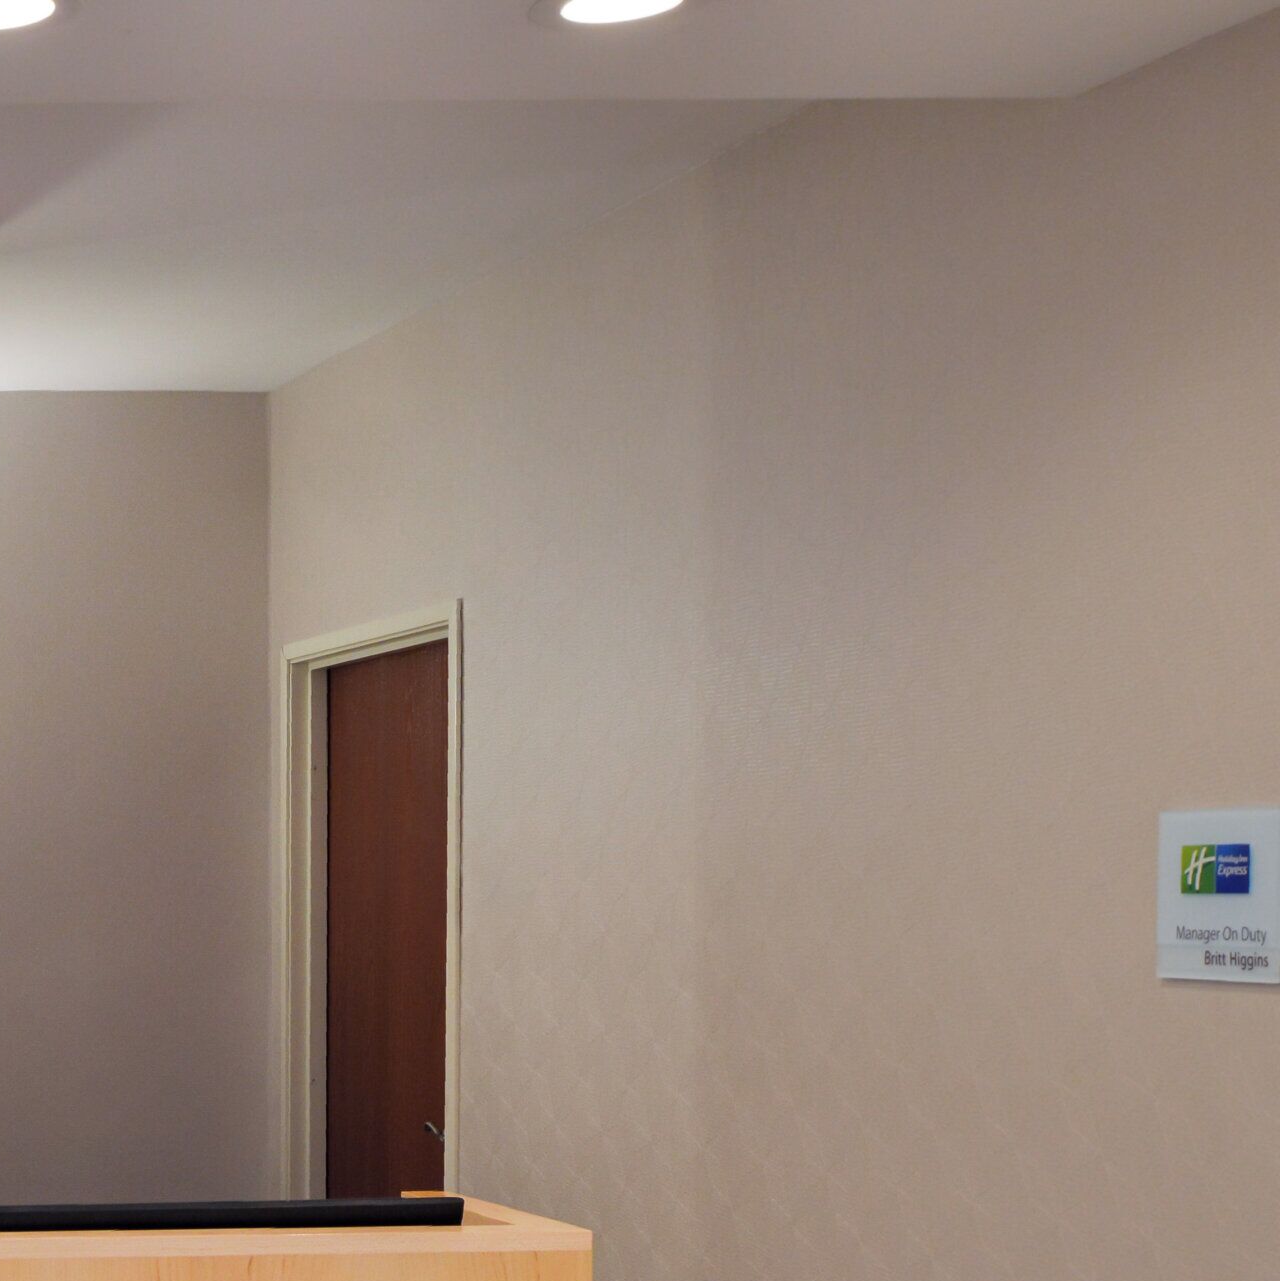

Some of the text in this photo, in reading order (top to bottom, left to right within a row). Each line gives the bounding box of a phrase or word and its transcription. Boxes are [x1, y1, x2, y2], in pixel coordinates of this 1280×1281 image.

[1217, 864, 1248, 878] Express
[1176, 925, 1267, 946] Manager On Duty
[1204, 950, 1269, 972] Britt Higgins
